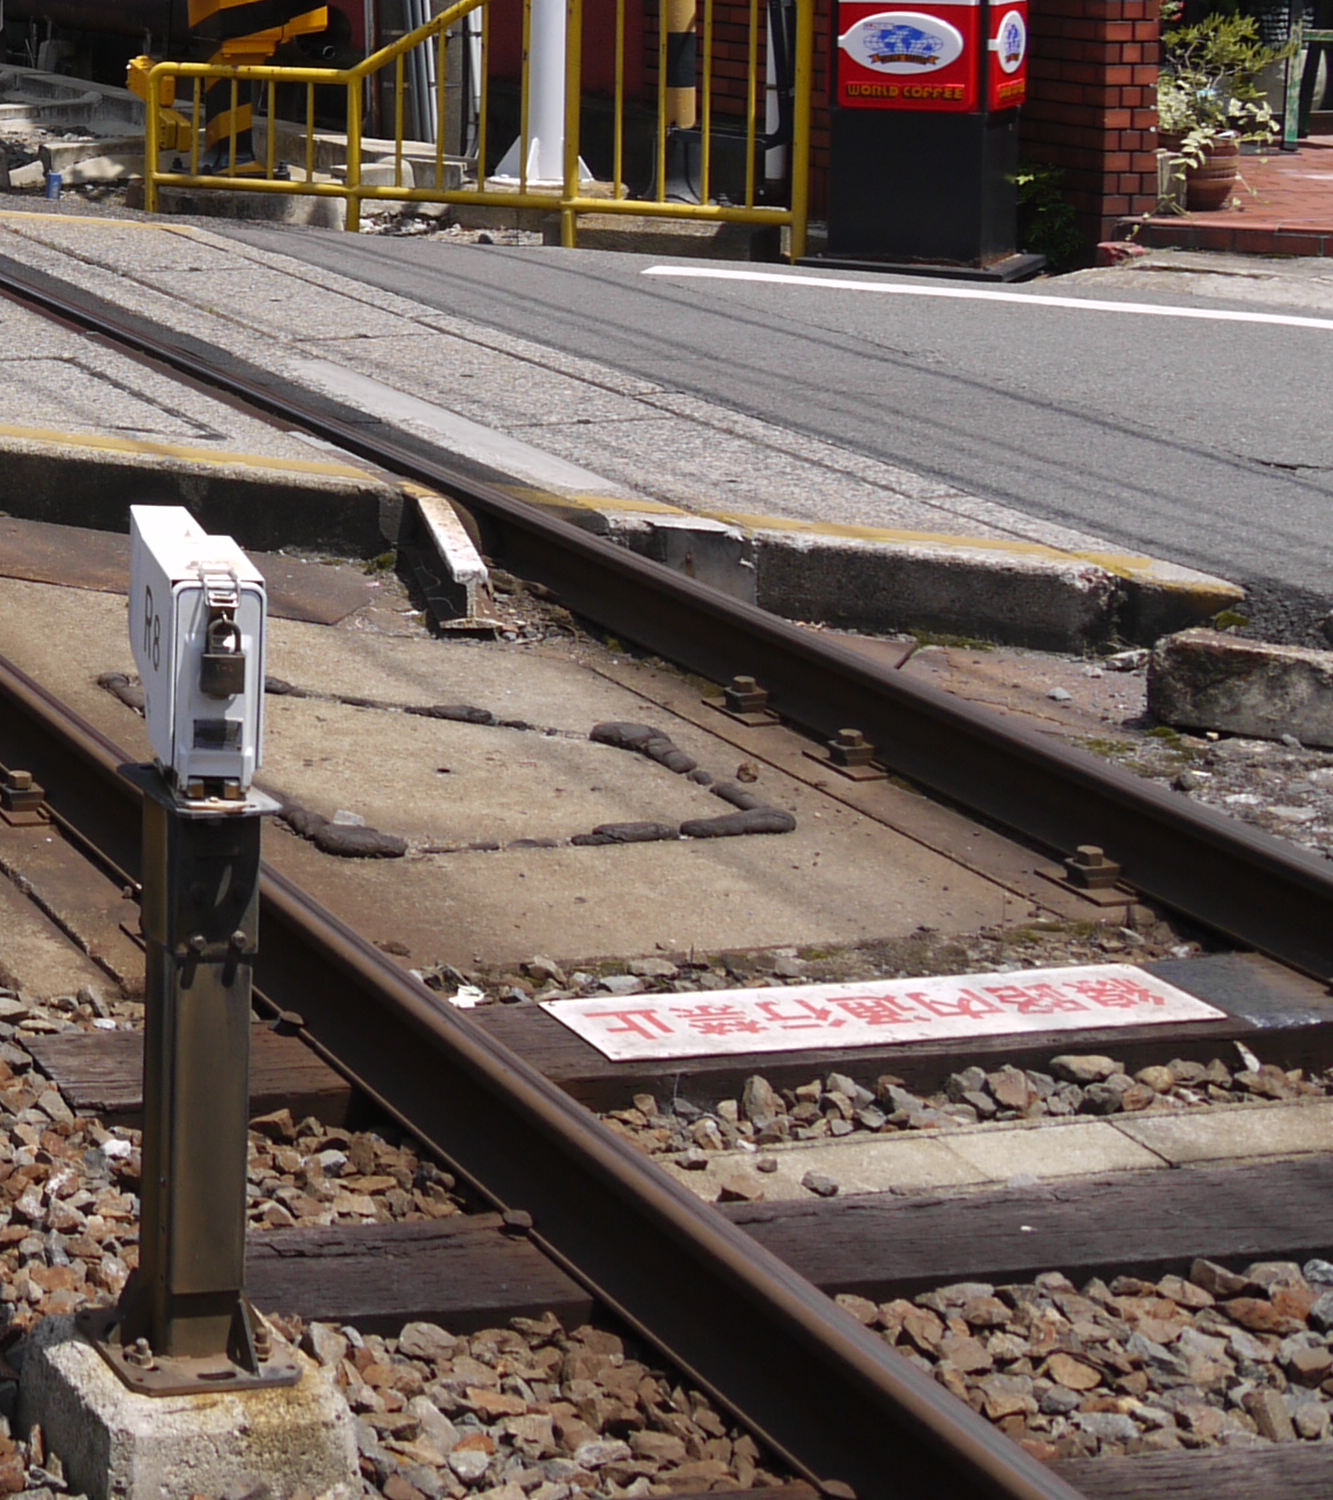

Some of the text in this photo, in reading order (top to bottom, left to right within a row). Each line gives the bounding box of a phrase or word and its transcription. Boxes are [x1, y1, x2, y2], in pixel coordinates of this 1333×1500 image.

[847, 85, 965, 100] WORLD COFFEE
[144, 584, 161, 672] R8
[583, 978, 1166, 1041] 線路内通行禁止
